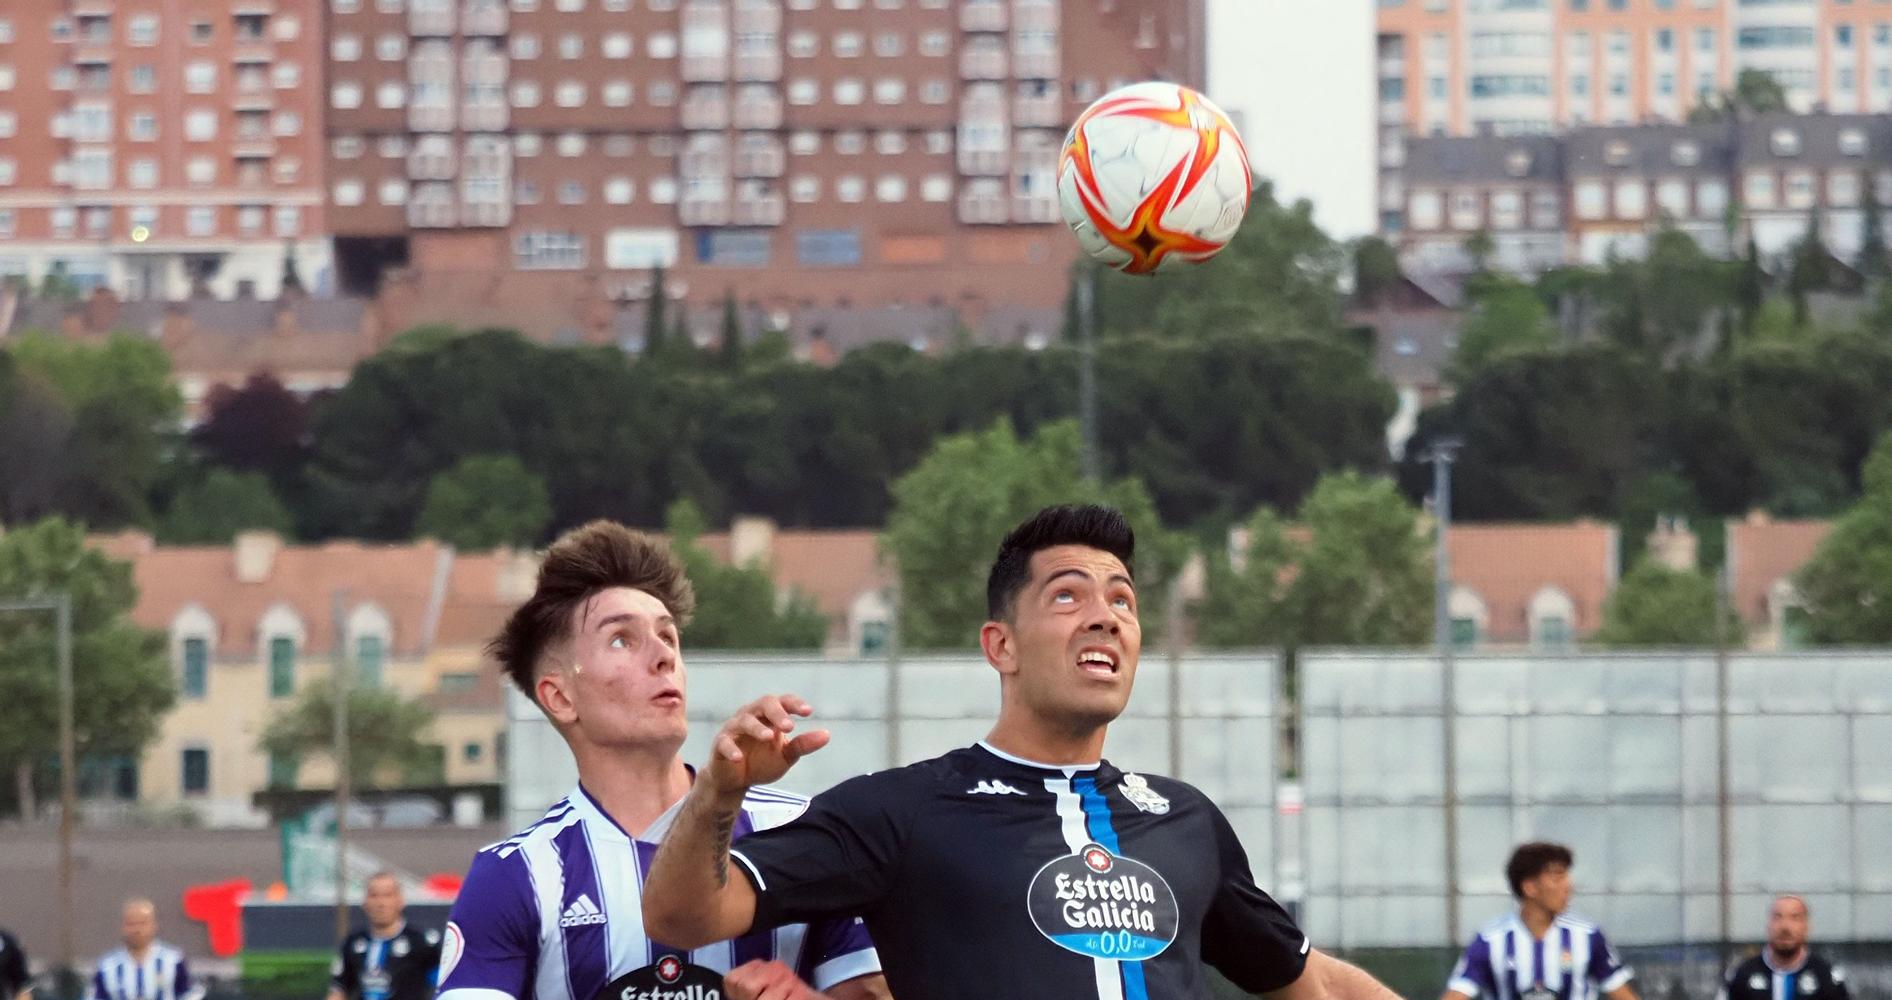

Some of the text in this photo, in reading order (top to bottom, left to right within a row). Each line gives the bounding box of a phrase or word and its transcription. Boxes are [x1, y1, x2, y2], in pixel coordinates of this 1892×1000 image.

[1055, 872, 1156, 904] Estrella
[560, 914, 608, 928] adidas
[1063, 899, 1155, 932] Galicia
